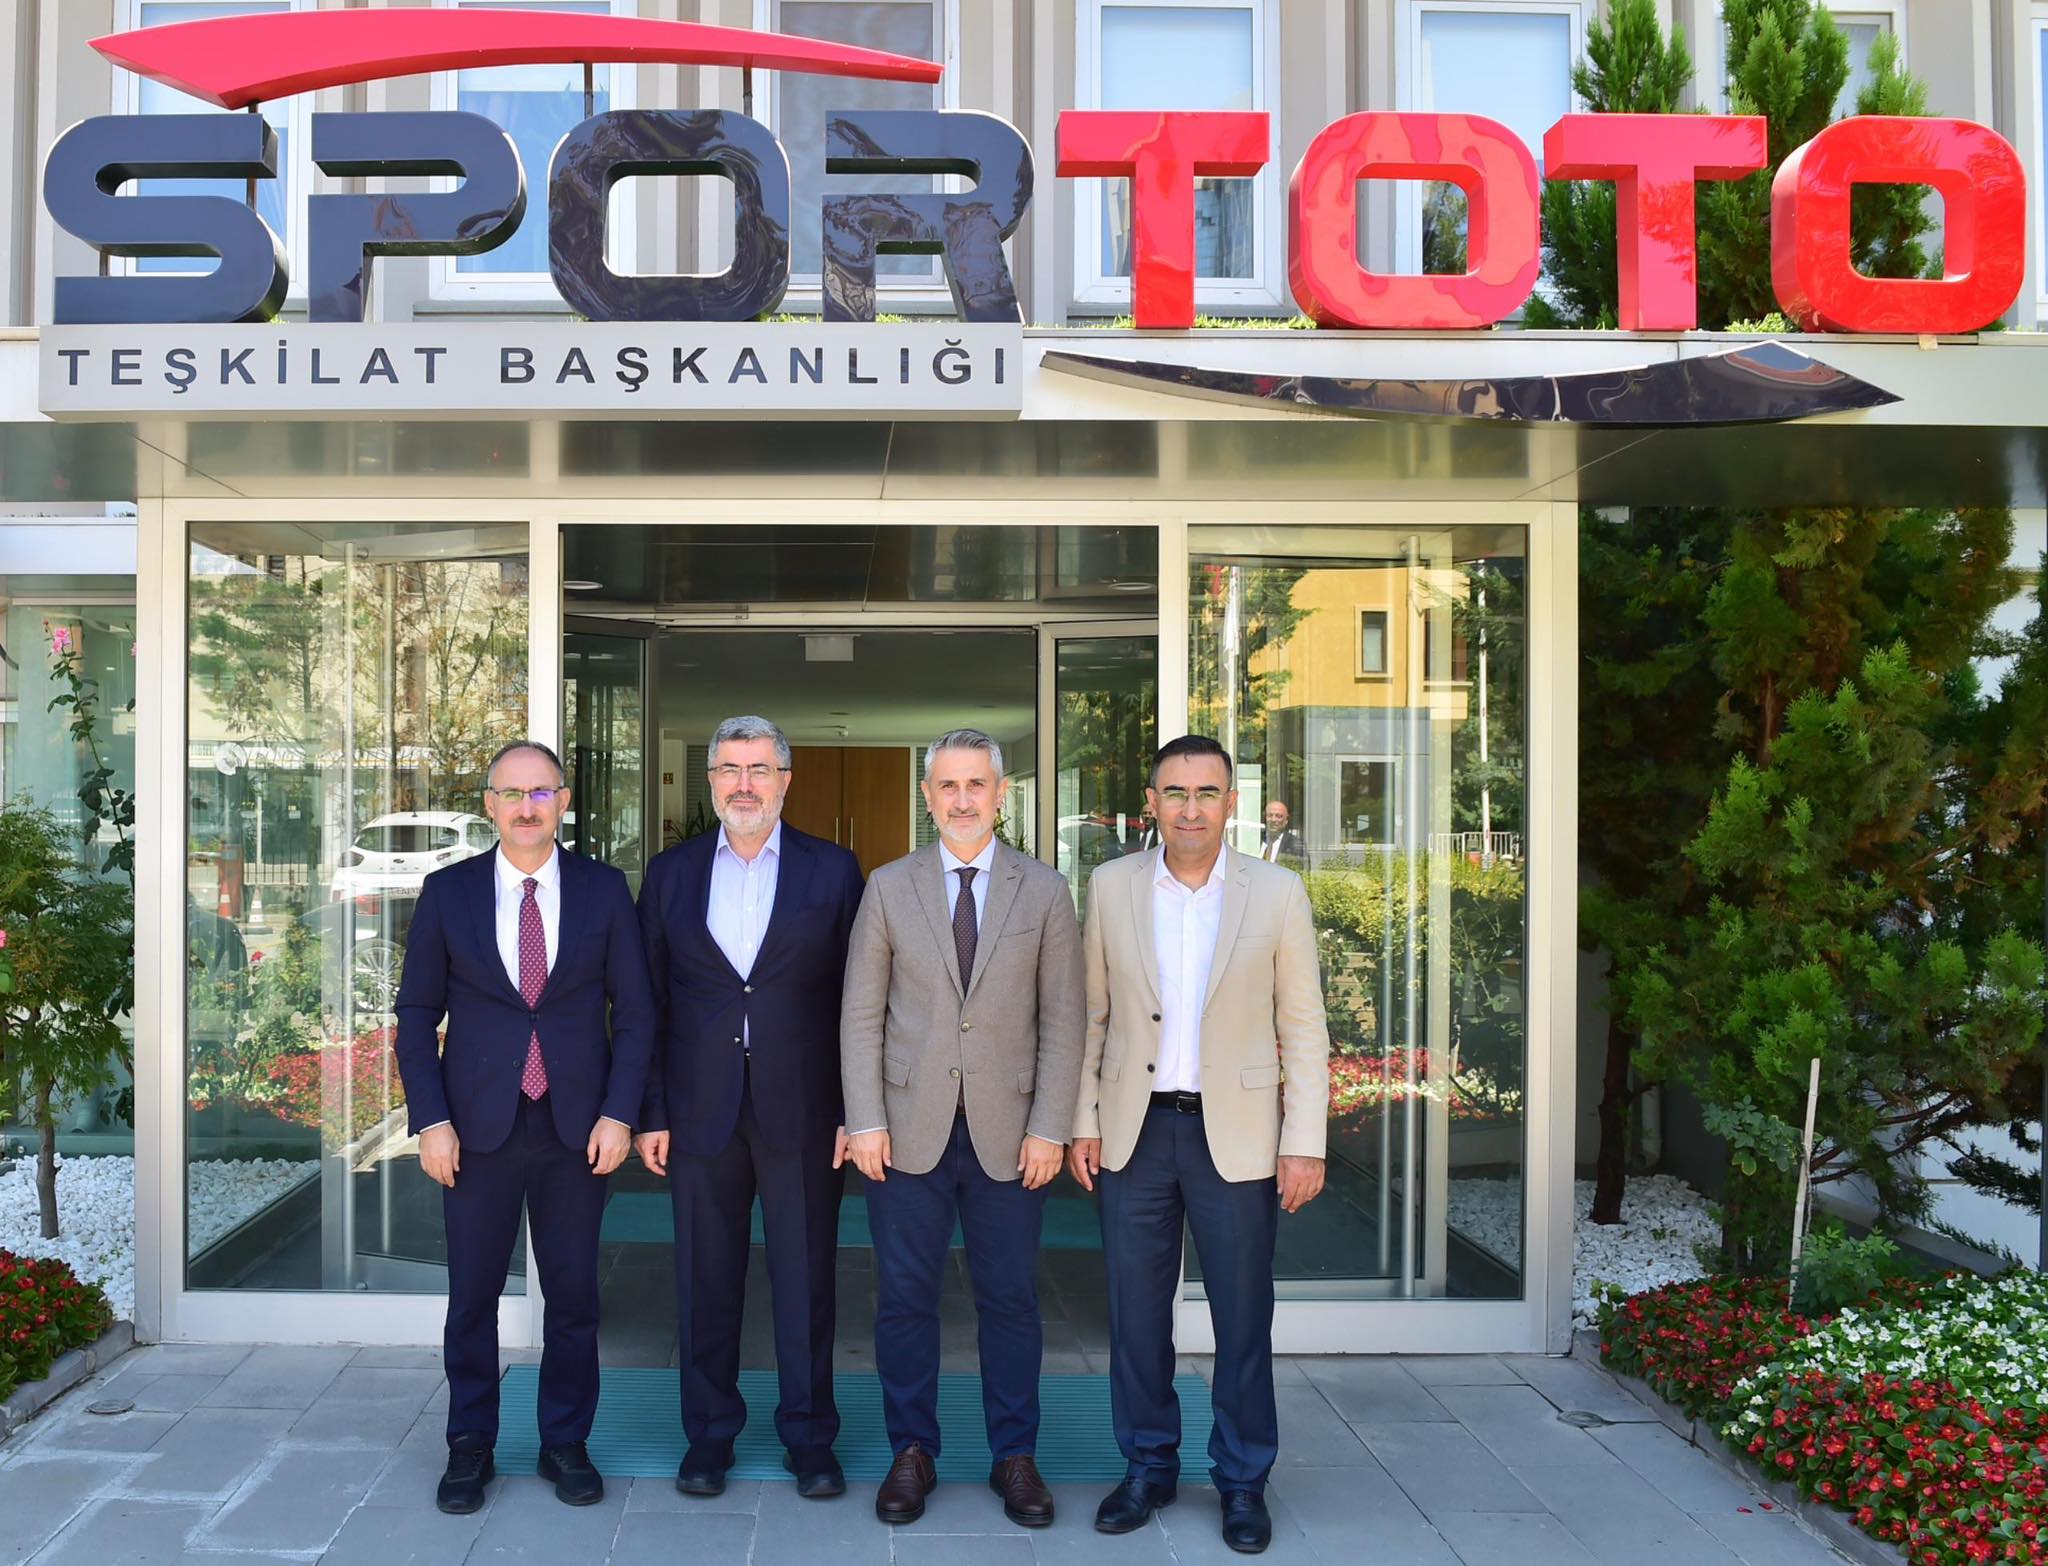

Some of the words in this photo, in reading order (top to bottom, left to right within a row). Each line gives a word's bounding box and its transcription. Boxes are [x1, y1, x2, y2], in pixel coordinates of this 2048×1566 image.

[43, 108, 1034, 324] SPOR
[1056, 110, 2026, 333] TOTO
[58, 339, 448, 394] TEŞKİLAT
[500, 338, 1005, 393] BAŞKANLIĞI
